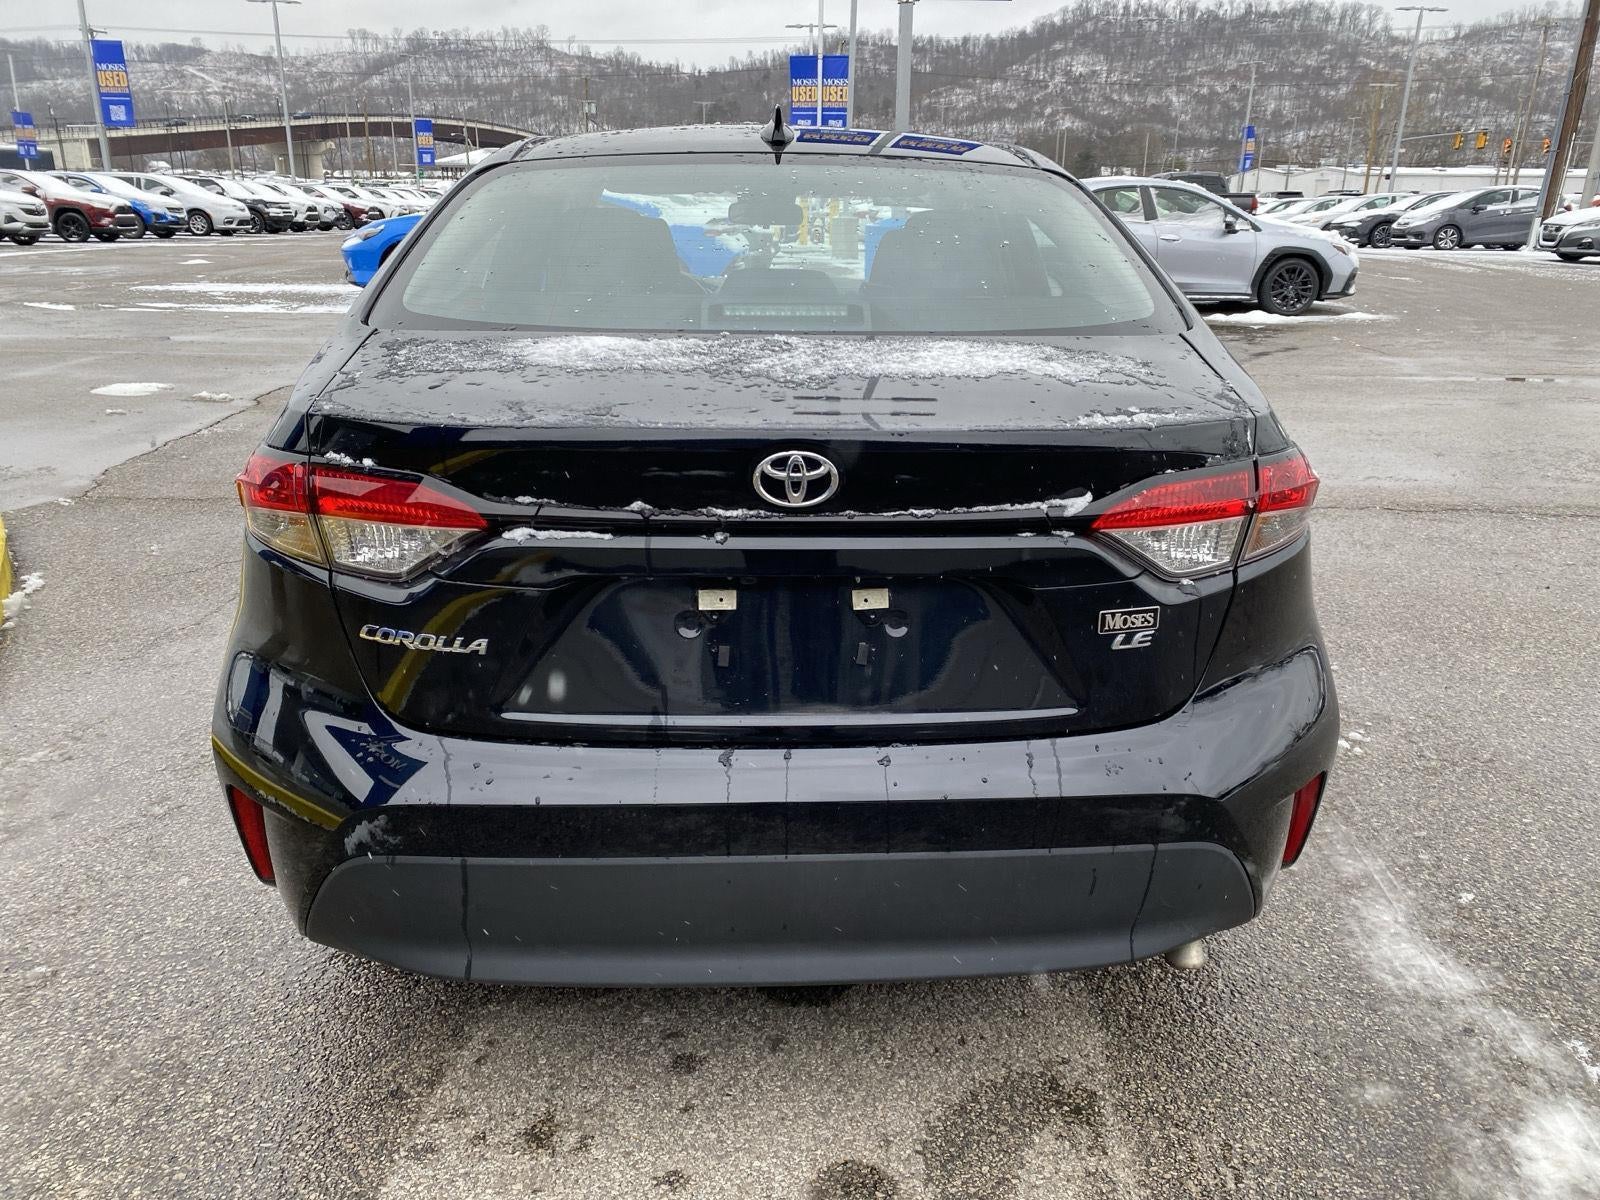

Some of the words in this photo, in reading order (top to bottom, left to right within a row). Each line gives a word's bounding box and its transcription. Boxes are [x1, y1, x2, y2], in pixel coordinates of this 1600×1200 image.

[96, 63, 126, 71] MOSES
[97, 71, 128, 87] USED
[792, 78, 818, 86] MOSES
[823, 78, 849, 86] MOSES
[792, 86, 818, 102] USED
[823, 86, 849, 102] USED
[359, 624, 488, 655] COROLLA
[1111, 630, 1155, 650] LE
